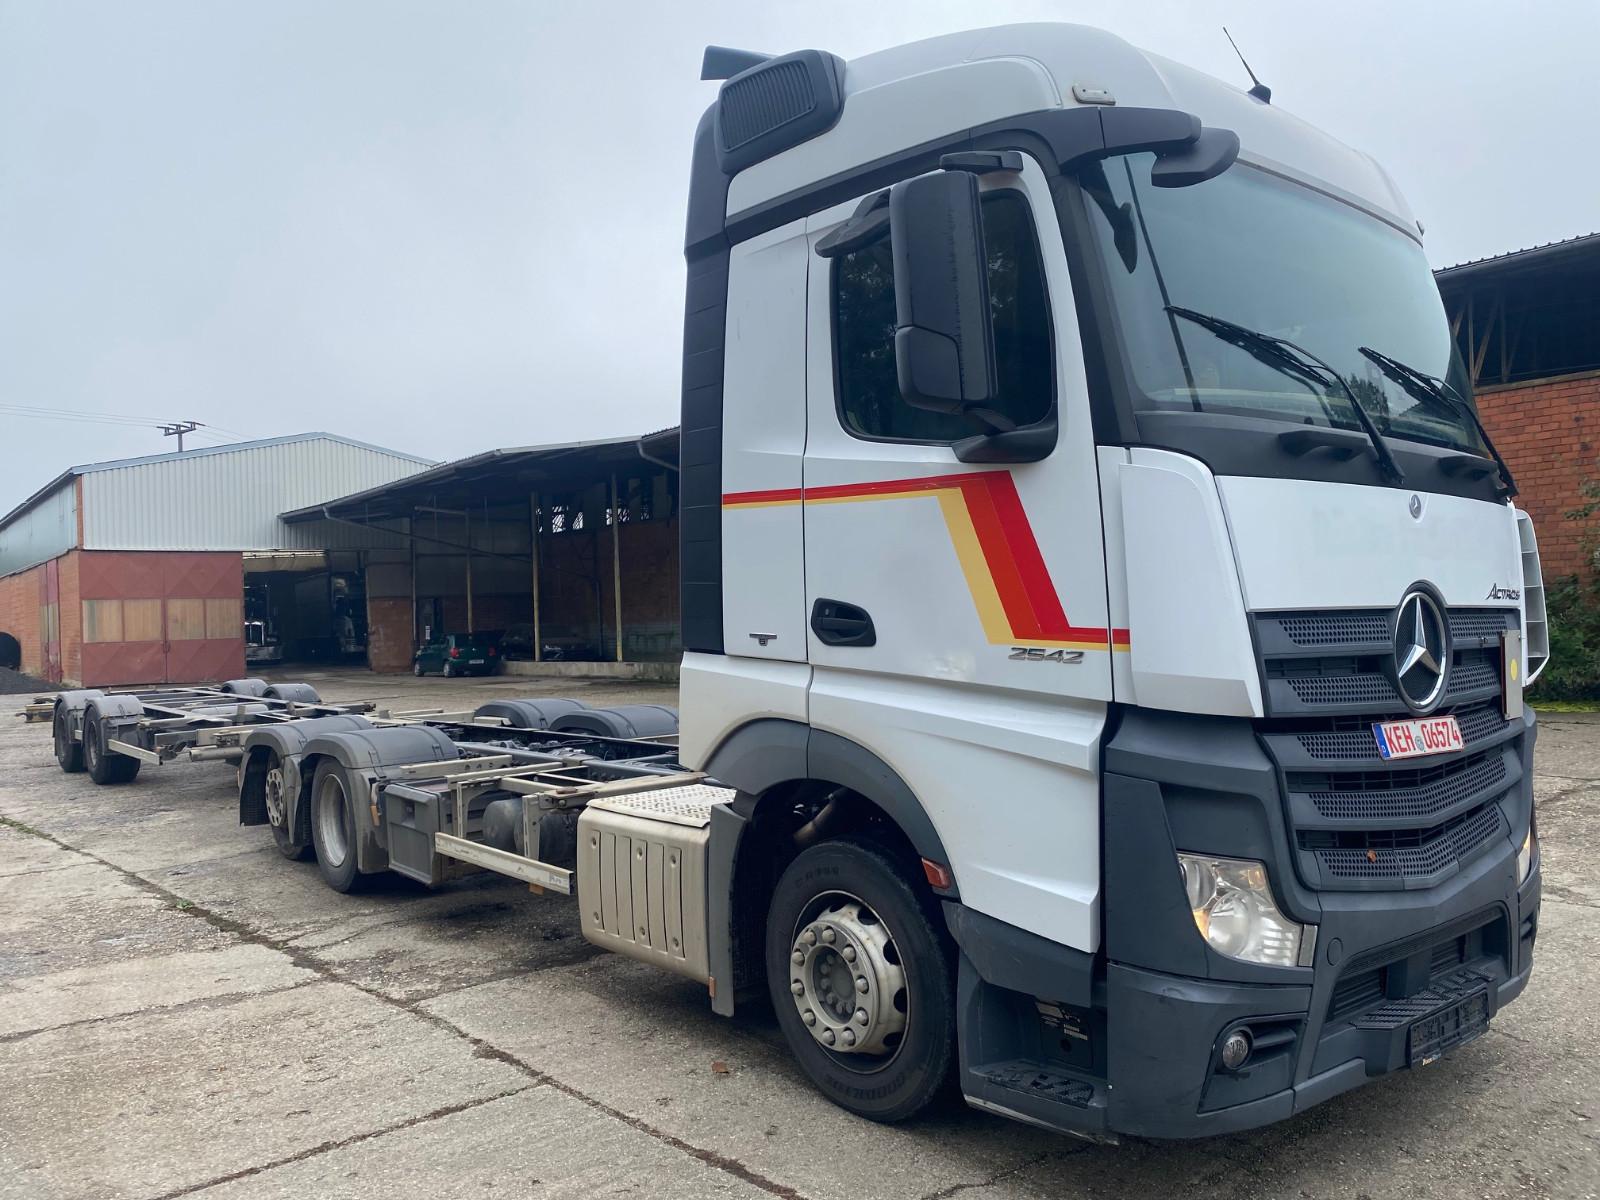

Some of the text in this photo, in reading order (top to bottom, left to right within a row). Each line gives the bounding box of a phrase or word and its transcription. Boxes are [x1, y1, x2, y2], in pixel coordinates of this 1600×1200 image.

[1008, 647, 1085, 664] 2542
[1384, 721, 1460, 754] KEH 06574
